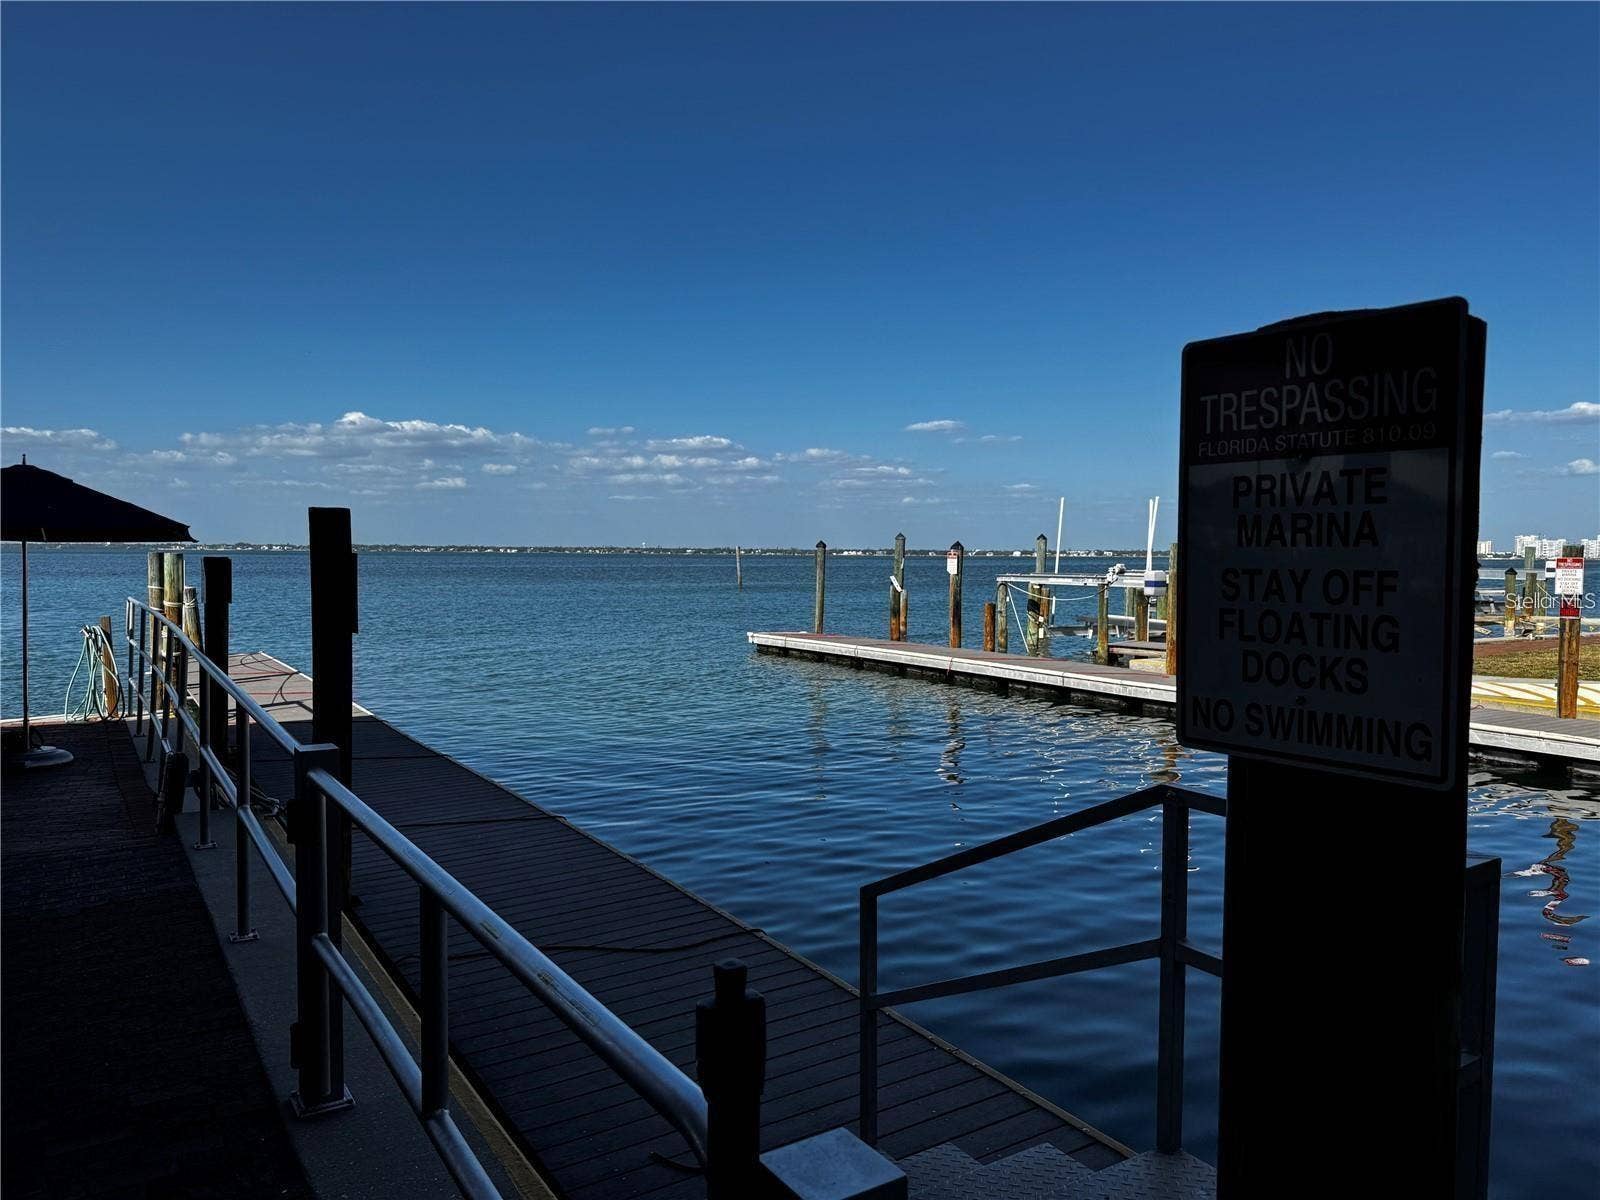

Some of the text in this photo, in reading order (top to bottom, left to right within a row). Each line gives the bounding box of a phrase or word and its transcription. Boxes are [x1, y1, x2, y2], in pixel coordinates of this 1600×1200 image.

[1285, 333, 1335, 380] NO
[1199, 366, 1438, 435] TRESPASSING
[1198, 437, 1268, 457] FLORIDA
[1274, 429, 1354, 452] STATUTE
[1232, 468, 1387, 508] PRIVATE
[1237, 510, 1379, 547] MARINA
[1220, 568, 1399, 606] STAY OFF
[1218, 608, 1401, 653] FLOATING
[1241, 651, 1369, 694] DOCKS
[1192, 697, 1433, 762] NO SWIMMING
